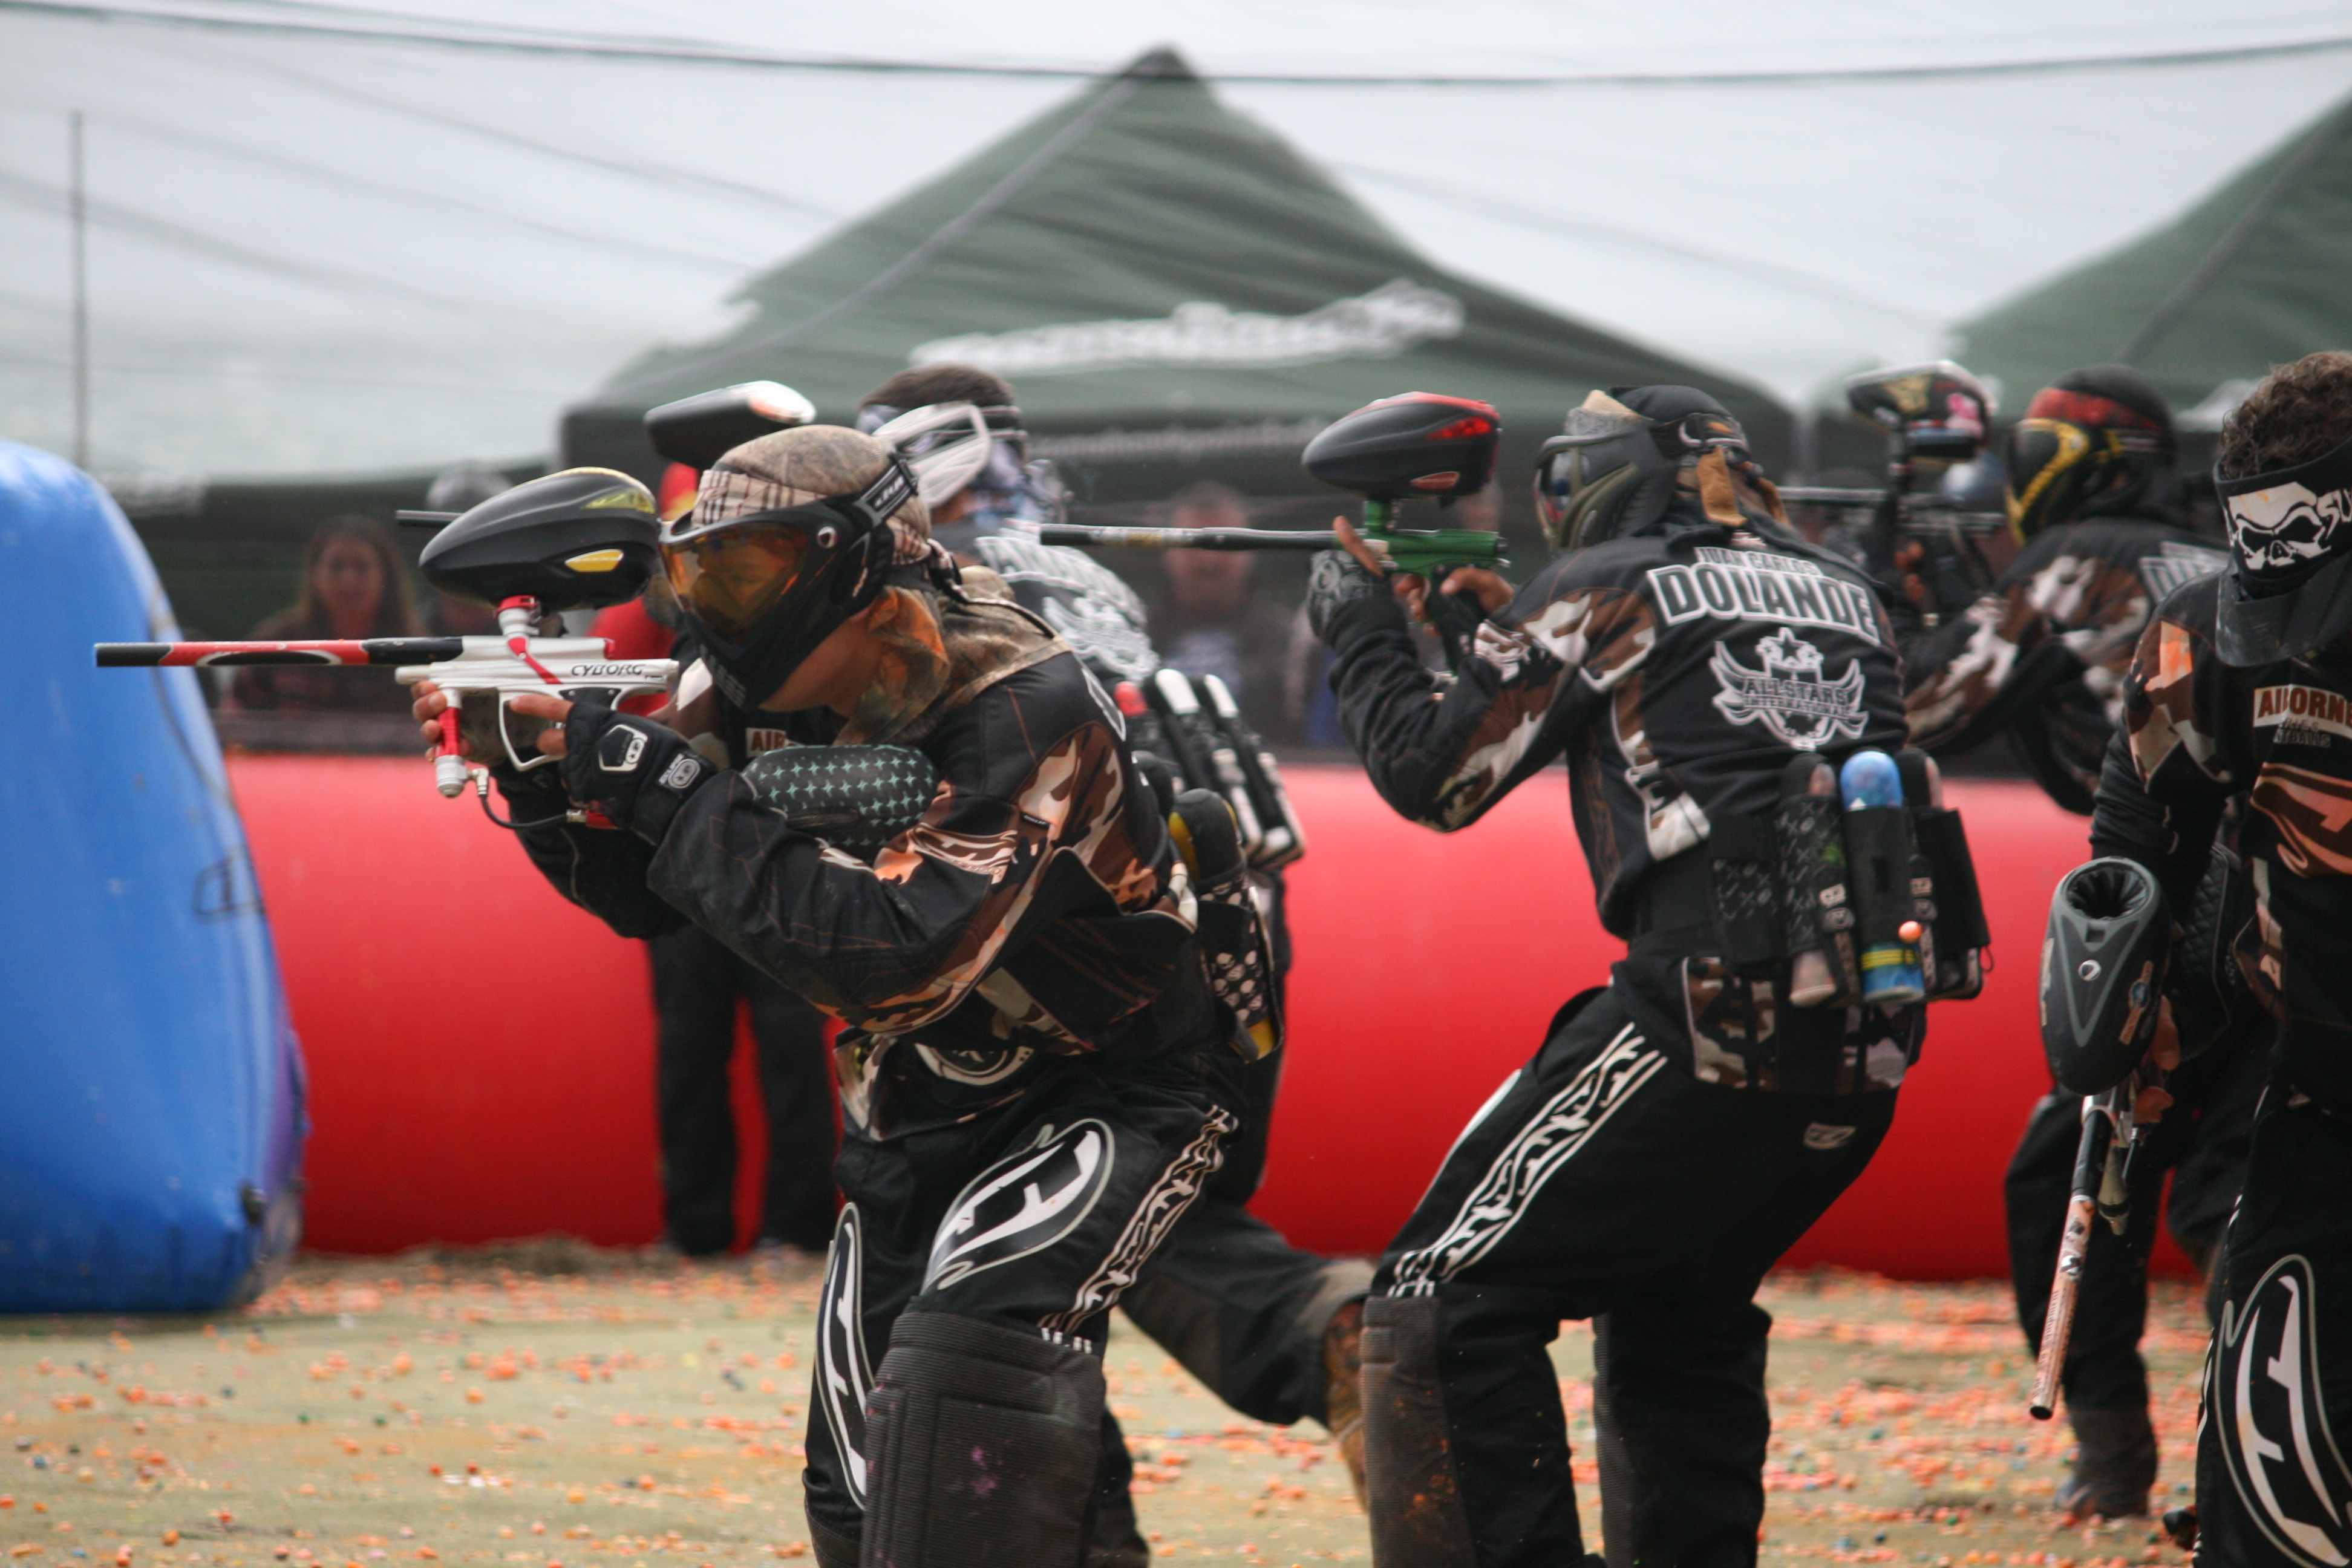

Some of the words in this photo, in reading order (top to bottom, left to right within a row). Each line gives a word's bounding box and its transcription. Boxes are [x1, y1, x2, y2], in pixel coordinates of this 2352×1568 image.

[1697, 547, 1745, 568] JUAN
[1747, 552, 1820, 575] CARLOS
[1650, 563, 1879, 645] DOLANDE
[572, 664, 645, 676] CYBORG
